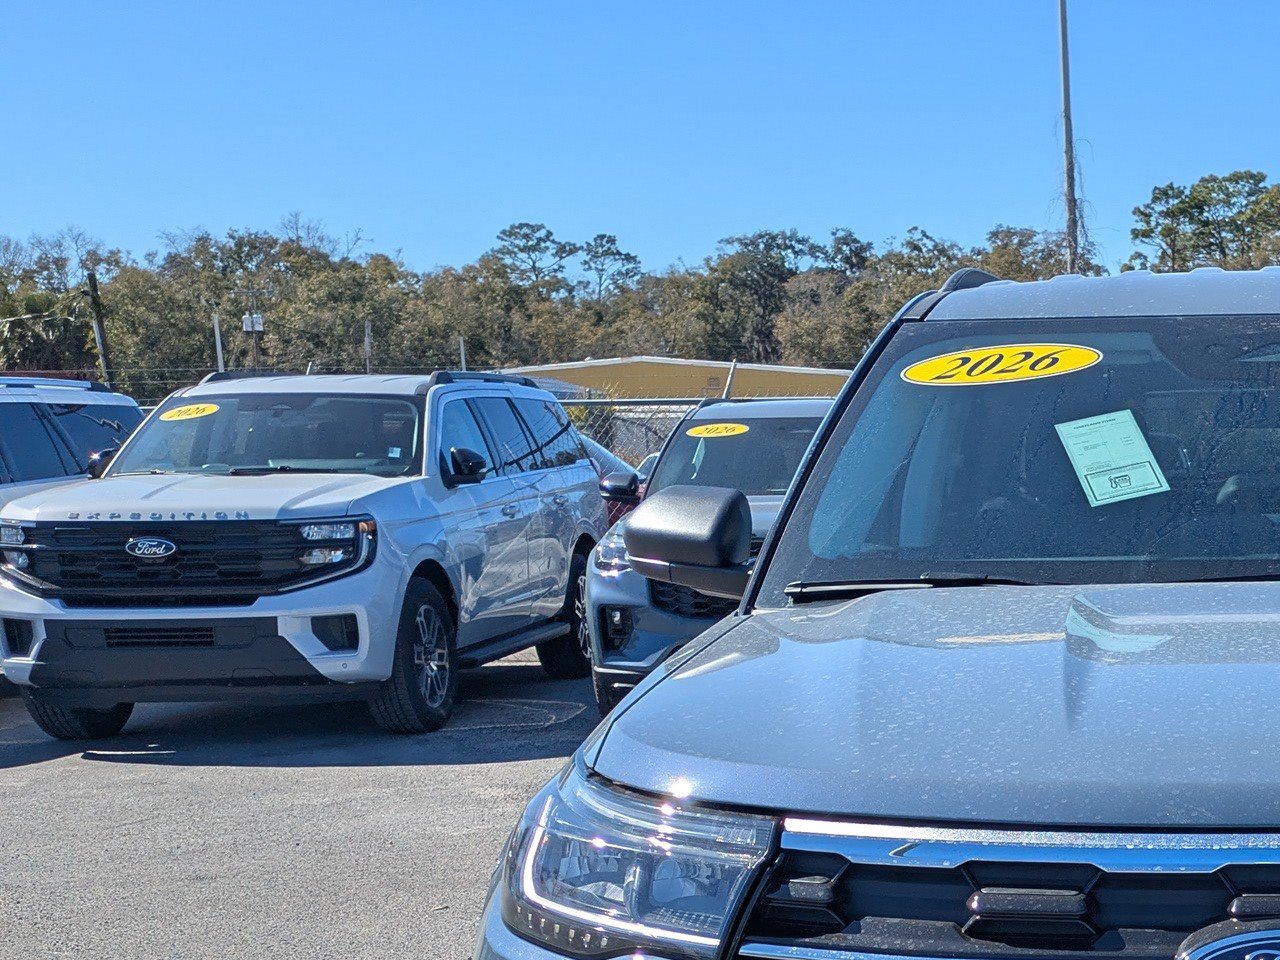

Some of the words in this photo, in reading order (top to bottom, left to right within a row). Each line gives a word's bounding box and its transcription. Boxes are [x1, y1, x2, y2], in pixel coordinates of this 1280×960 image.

[929, 348, 1072, 382] 2026
[695, 426, 736, 435] 2026
[67, 511, 250, 521] EXPEDITION
[135, 541, 166, 555] Ford
